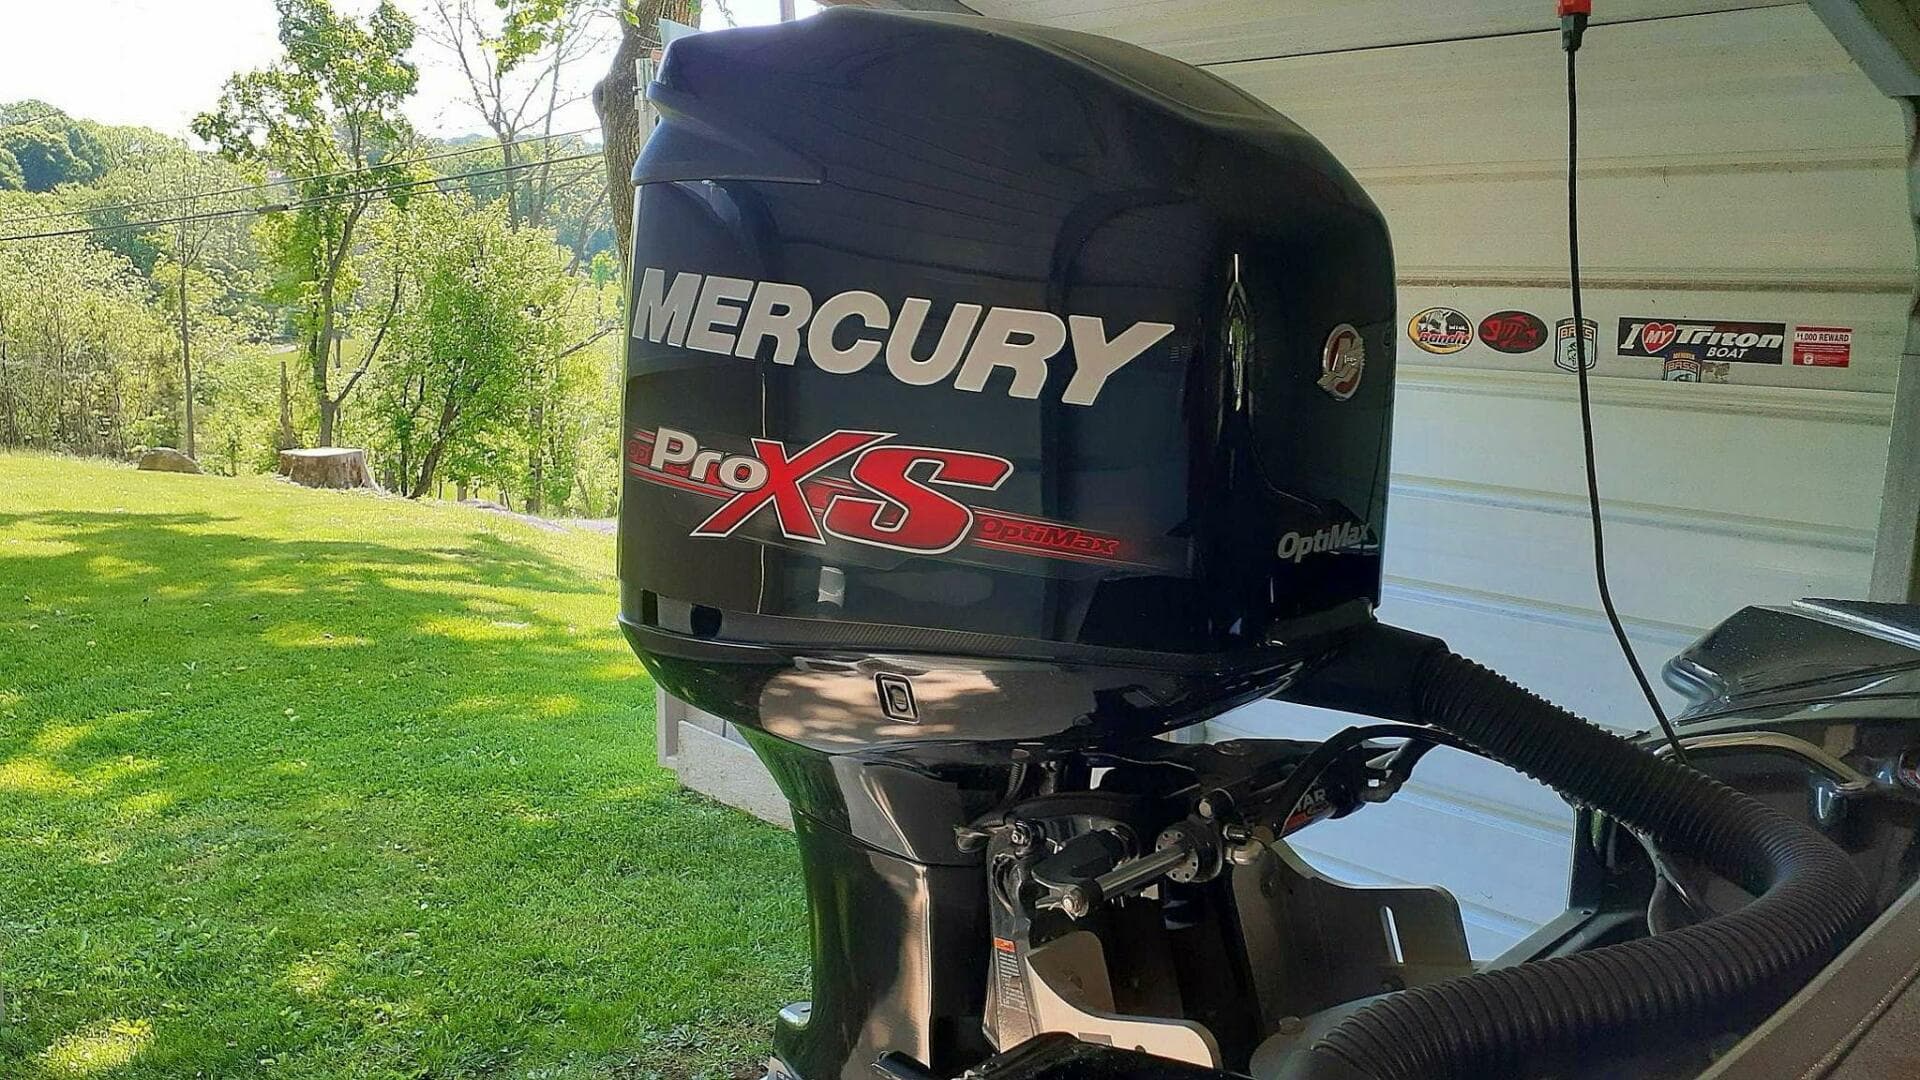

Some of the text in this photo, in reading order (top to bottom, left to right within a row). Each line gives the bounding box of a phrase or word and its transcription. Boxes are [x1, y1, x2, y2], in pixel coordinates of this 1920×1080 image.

[632, 268, 1175, 406] MERCURY
[1419, 331, 1469, 344] Bandit
[1561, 327, 1593, 339] BAS
[1620, 323, 1784, 349] I MY Triton
[1819, 333, 1849, 342] REWARD
[1706, 347, 1749, 359] BOAT
[980, 516, 1121, 555] OptiMax
[1277, 521, 1372, 563] OptiMax
